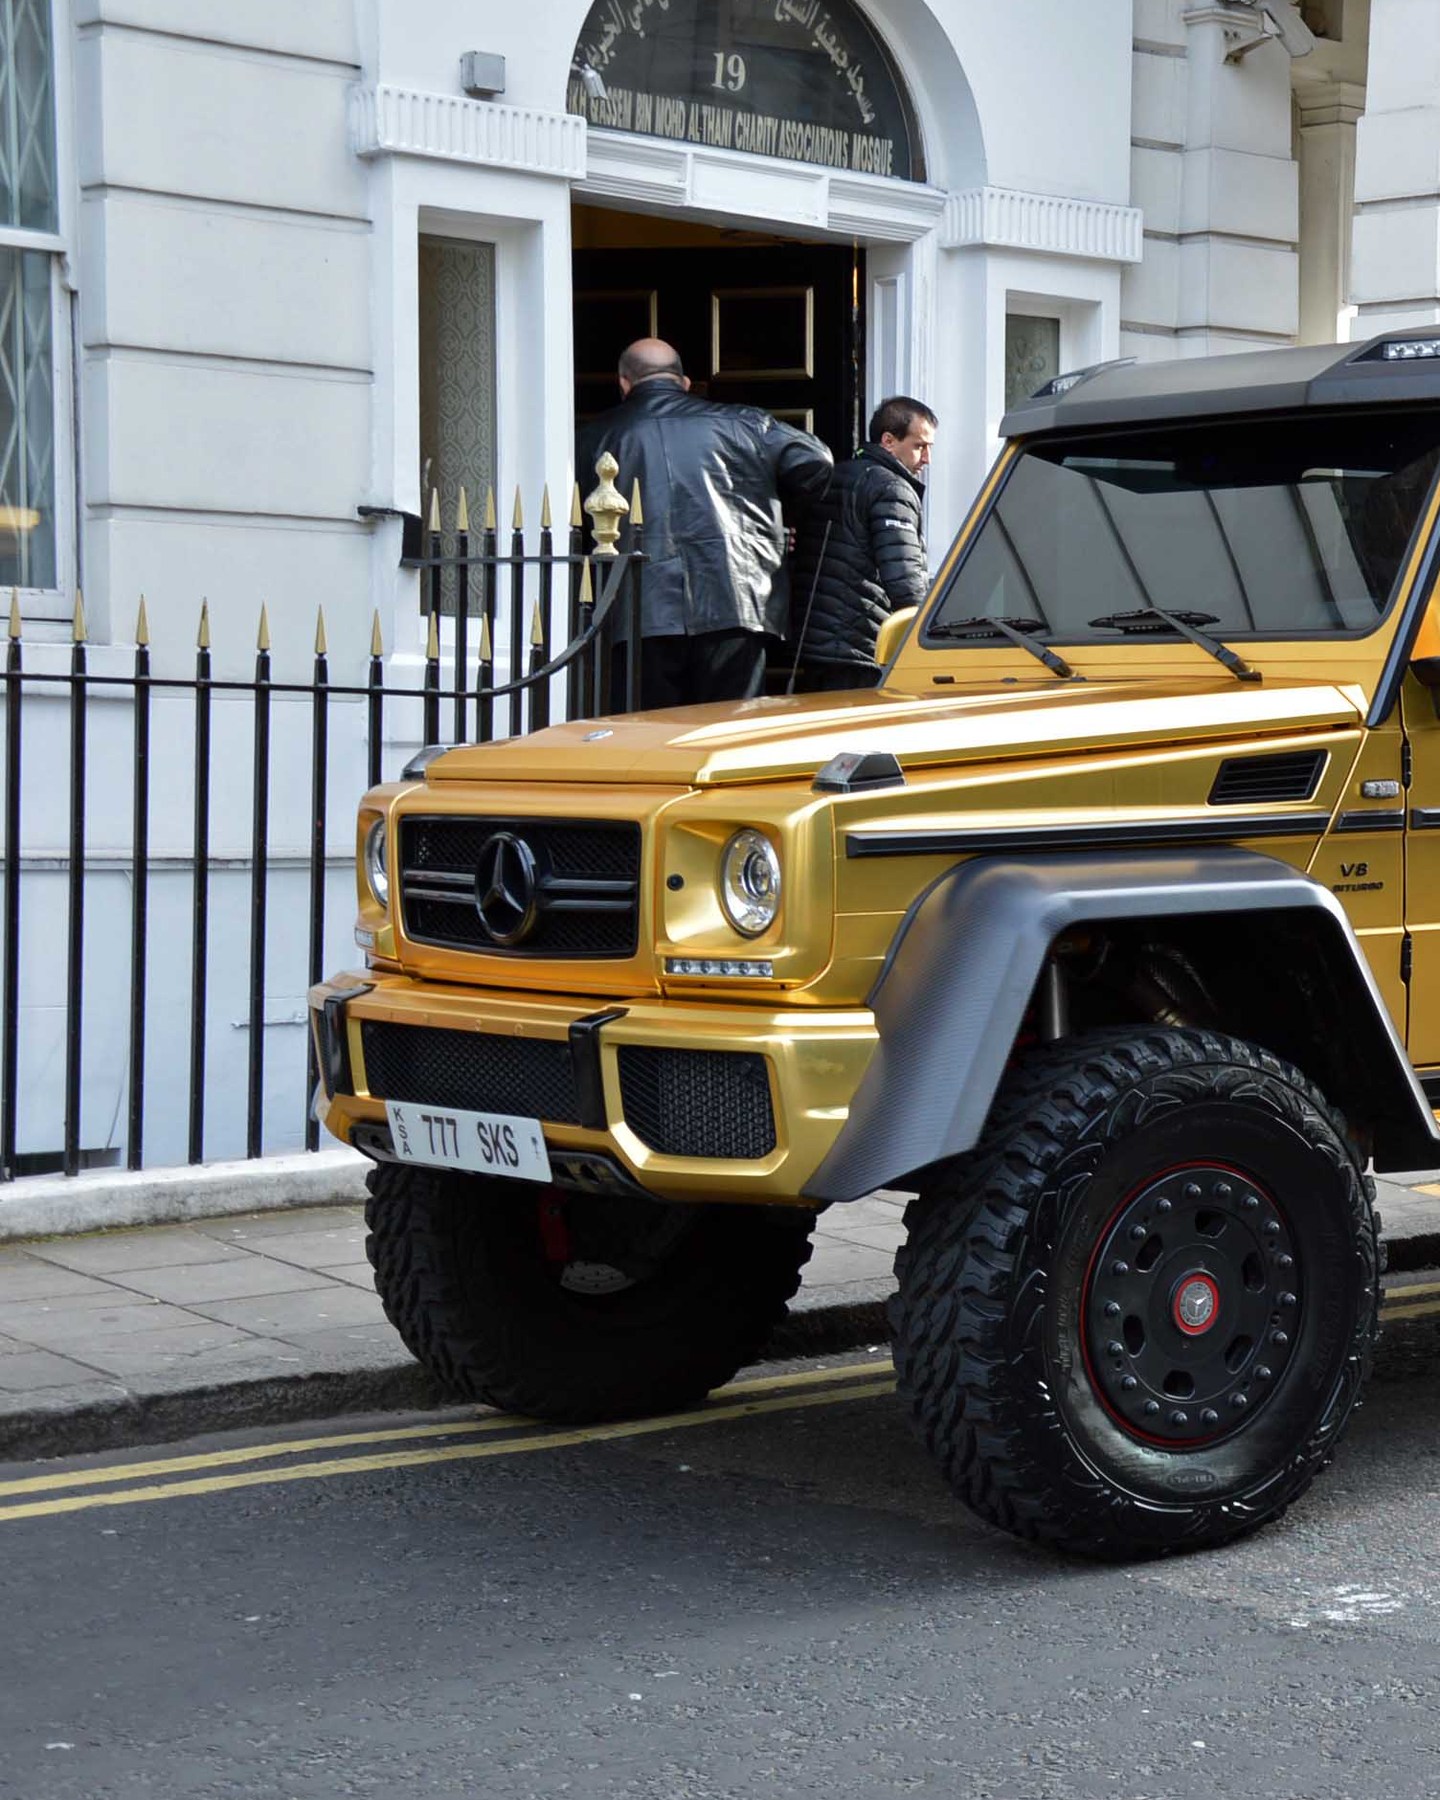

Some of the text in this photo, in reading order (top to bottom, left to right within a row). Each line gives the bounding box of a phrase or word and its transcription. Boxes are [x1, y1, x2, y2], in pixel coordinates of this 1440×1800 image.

[711, 52, 746, 92] 19
[635, 92, 653, 132] BIN
[655, 96, 686, 139] MOHD
[734, 111, 778, 157] CHARITY
[776, 119, 849, 169] ASSOCIATIONS
[851, 133, 893, 177] MOSQUE
[1340, 863, 1368, 877] V8
[421, 1114, 519, 1168] 777 SKS
